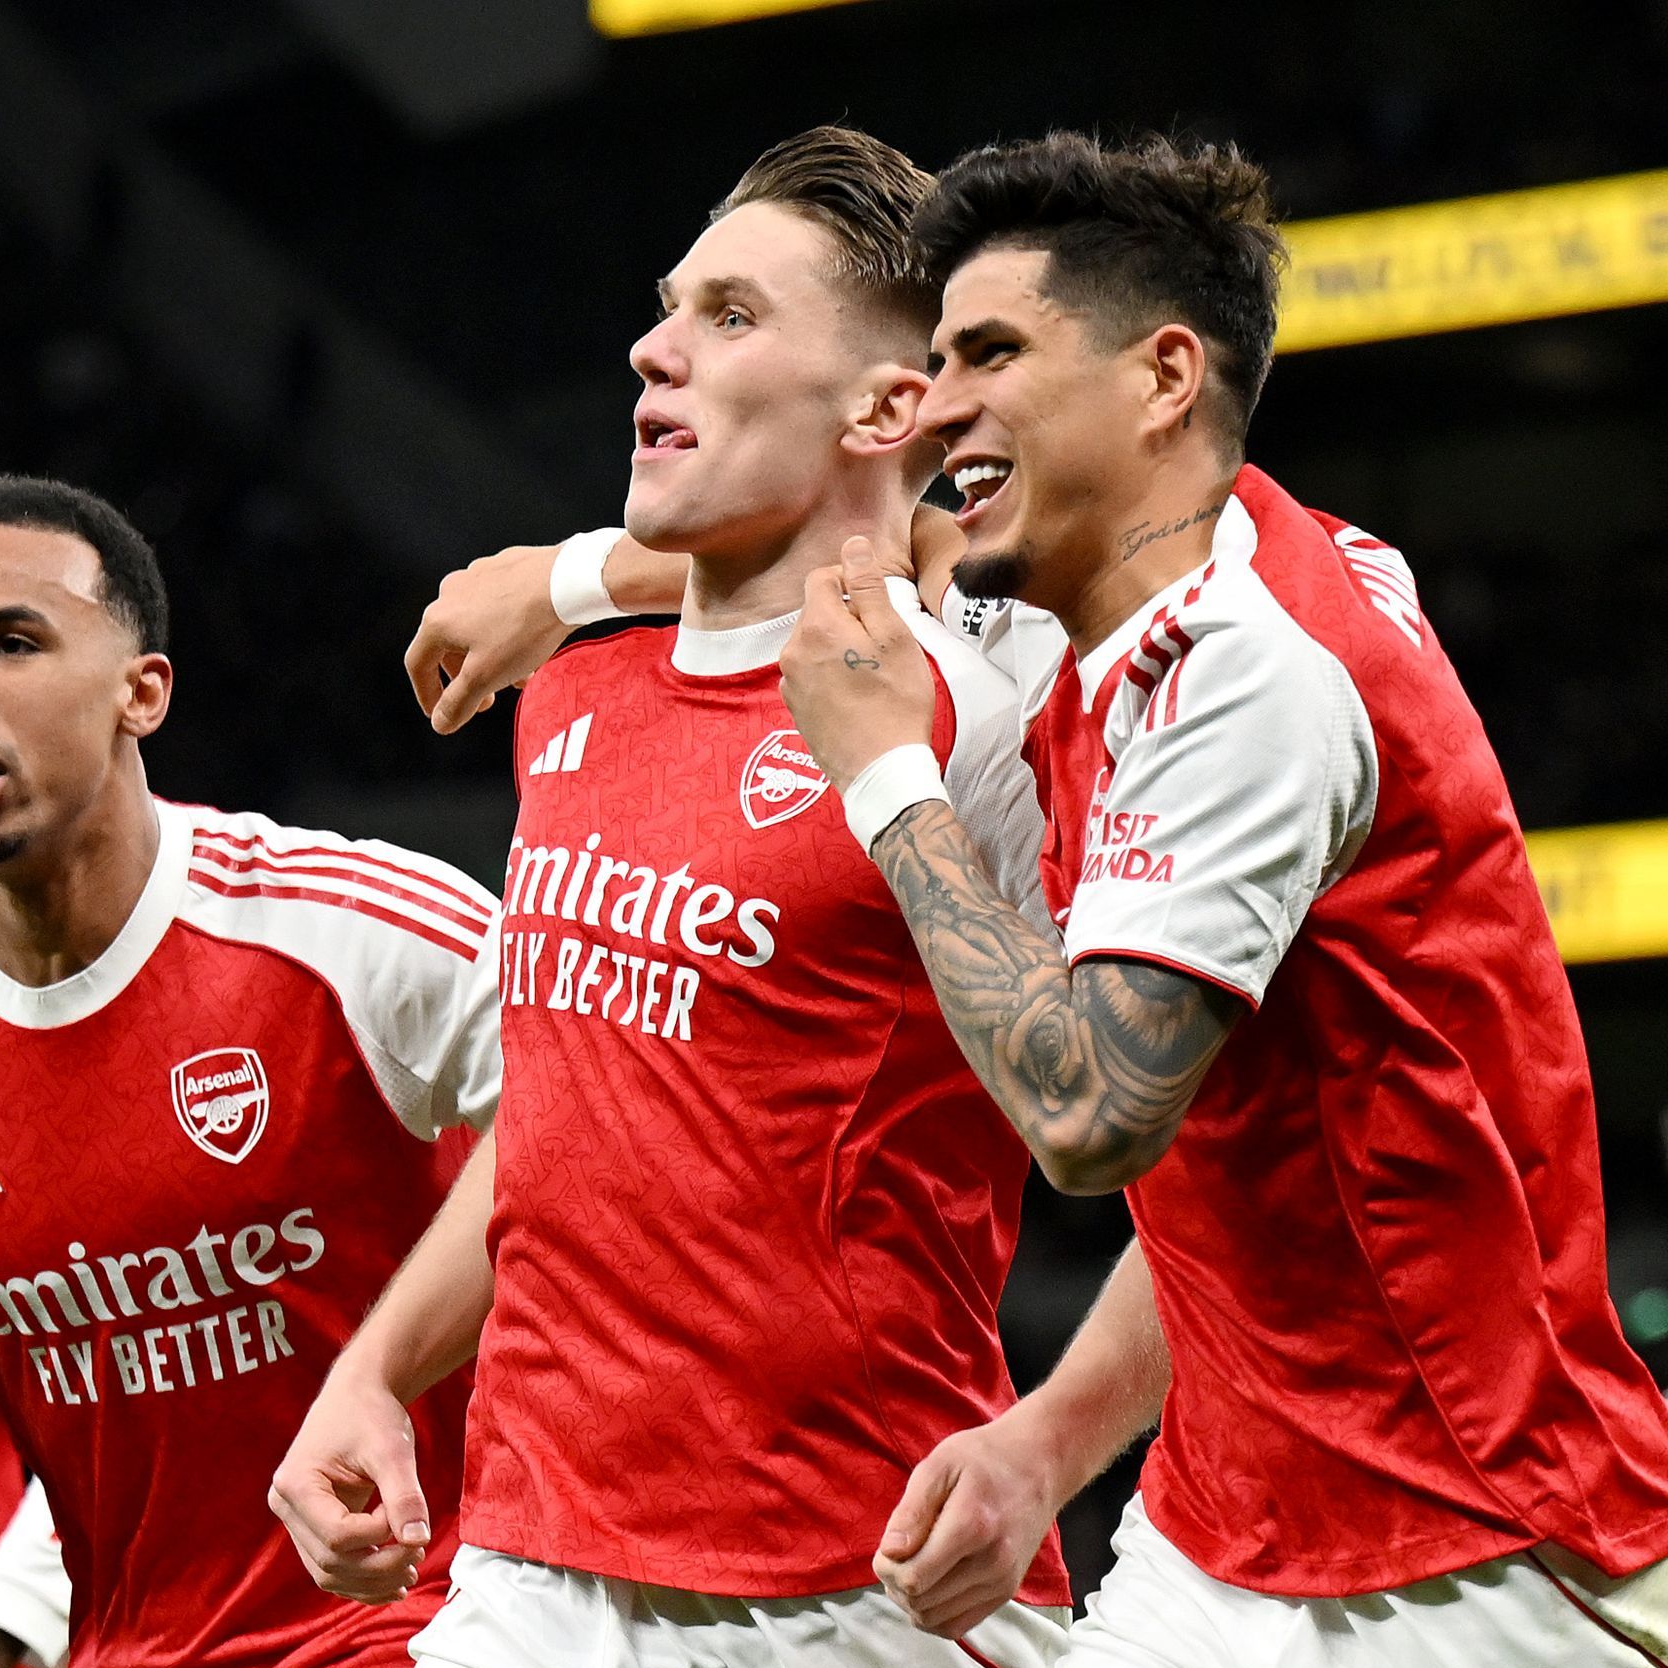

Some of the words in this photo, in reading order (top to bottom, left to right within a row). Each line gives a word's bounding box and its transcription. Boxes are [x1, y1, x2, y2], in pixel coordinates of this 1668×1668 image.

[764, 743, 821, 770] Arsen
[1101, 812, 1159, 846] ISIT
[1081, 848, 1175, 884] ANDA
[500, 931, 547, 1007] FLY
[546, 937, 700, 1042] BETTER
[185, 1063, 252, 1097] Arsenal
[28, 1339, 99, 1406] FLY
[110, 1300, 295, 1396] BETTER
